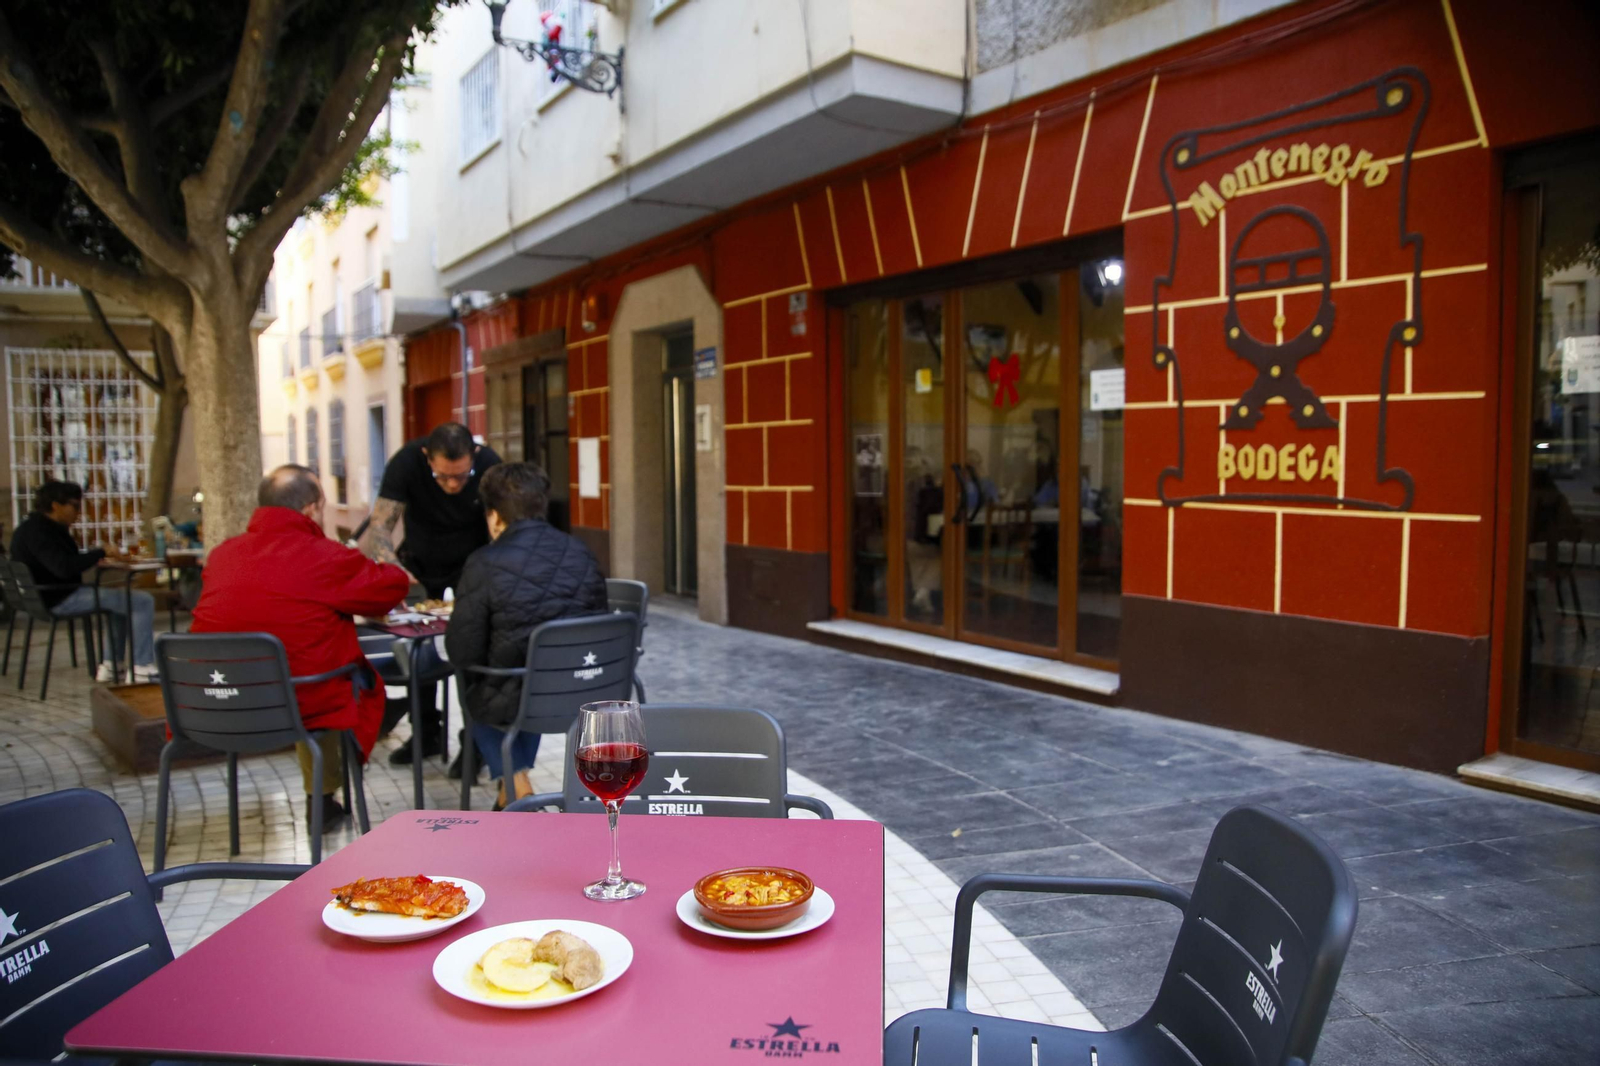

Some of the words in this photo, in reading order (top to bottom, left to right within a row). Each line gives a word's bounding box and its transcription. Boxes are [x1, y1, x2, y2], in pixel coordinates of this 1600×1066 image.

[1188, 142, 1389, 227] Montenegro
[1217, 442, 1342, 482] BODEGA
[648, 803, 704, 815] ESTRELLA
[0, 939, 51, 978] TRELLA
[7, 963, 32, 985] DAMM
[1245, 970, 1277, 1025] ESTRELLA
[730, 1038, 840, 1053] ESTRELLA
